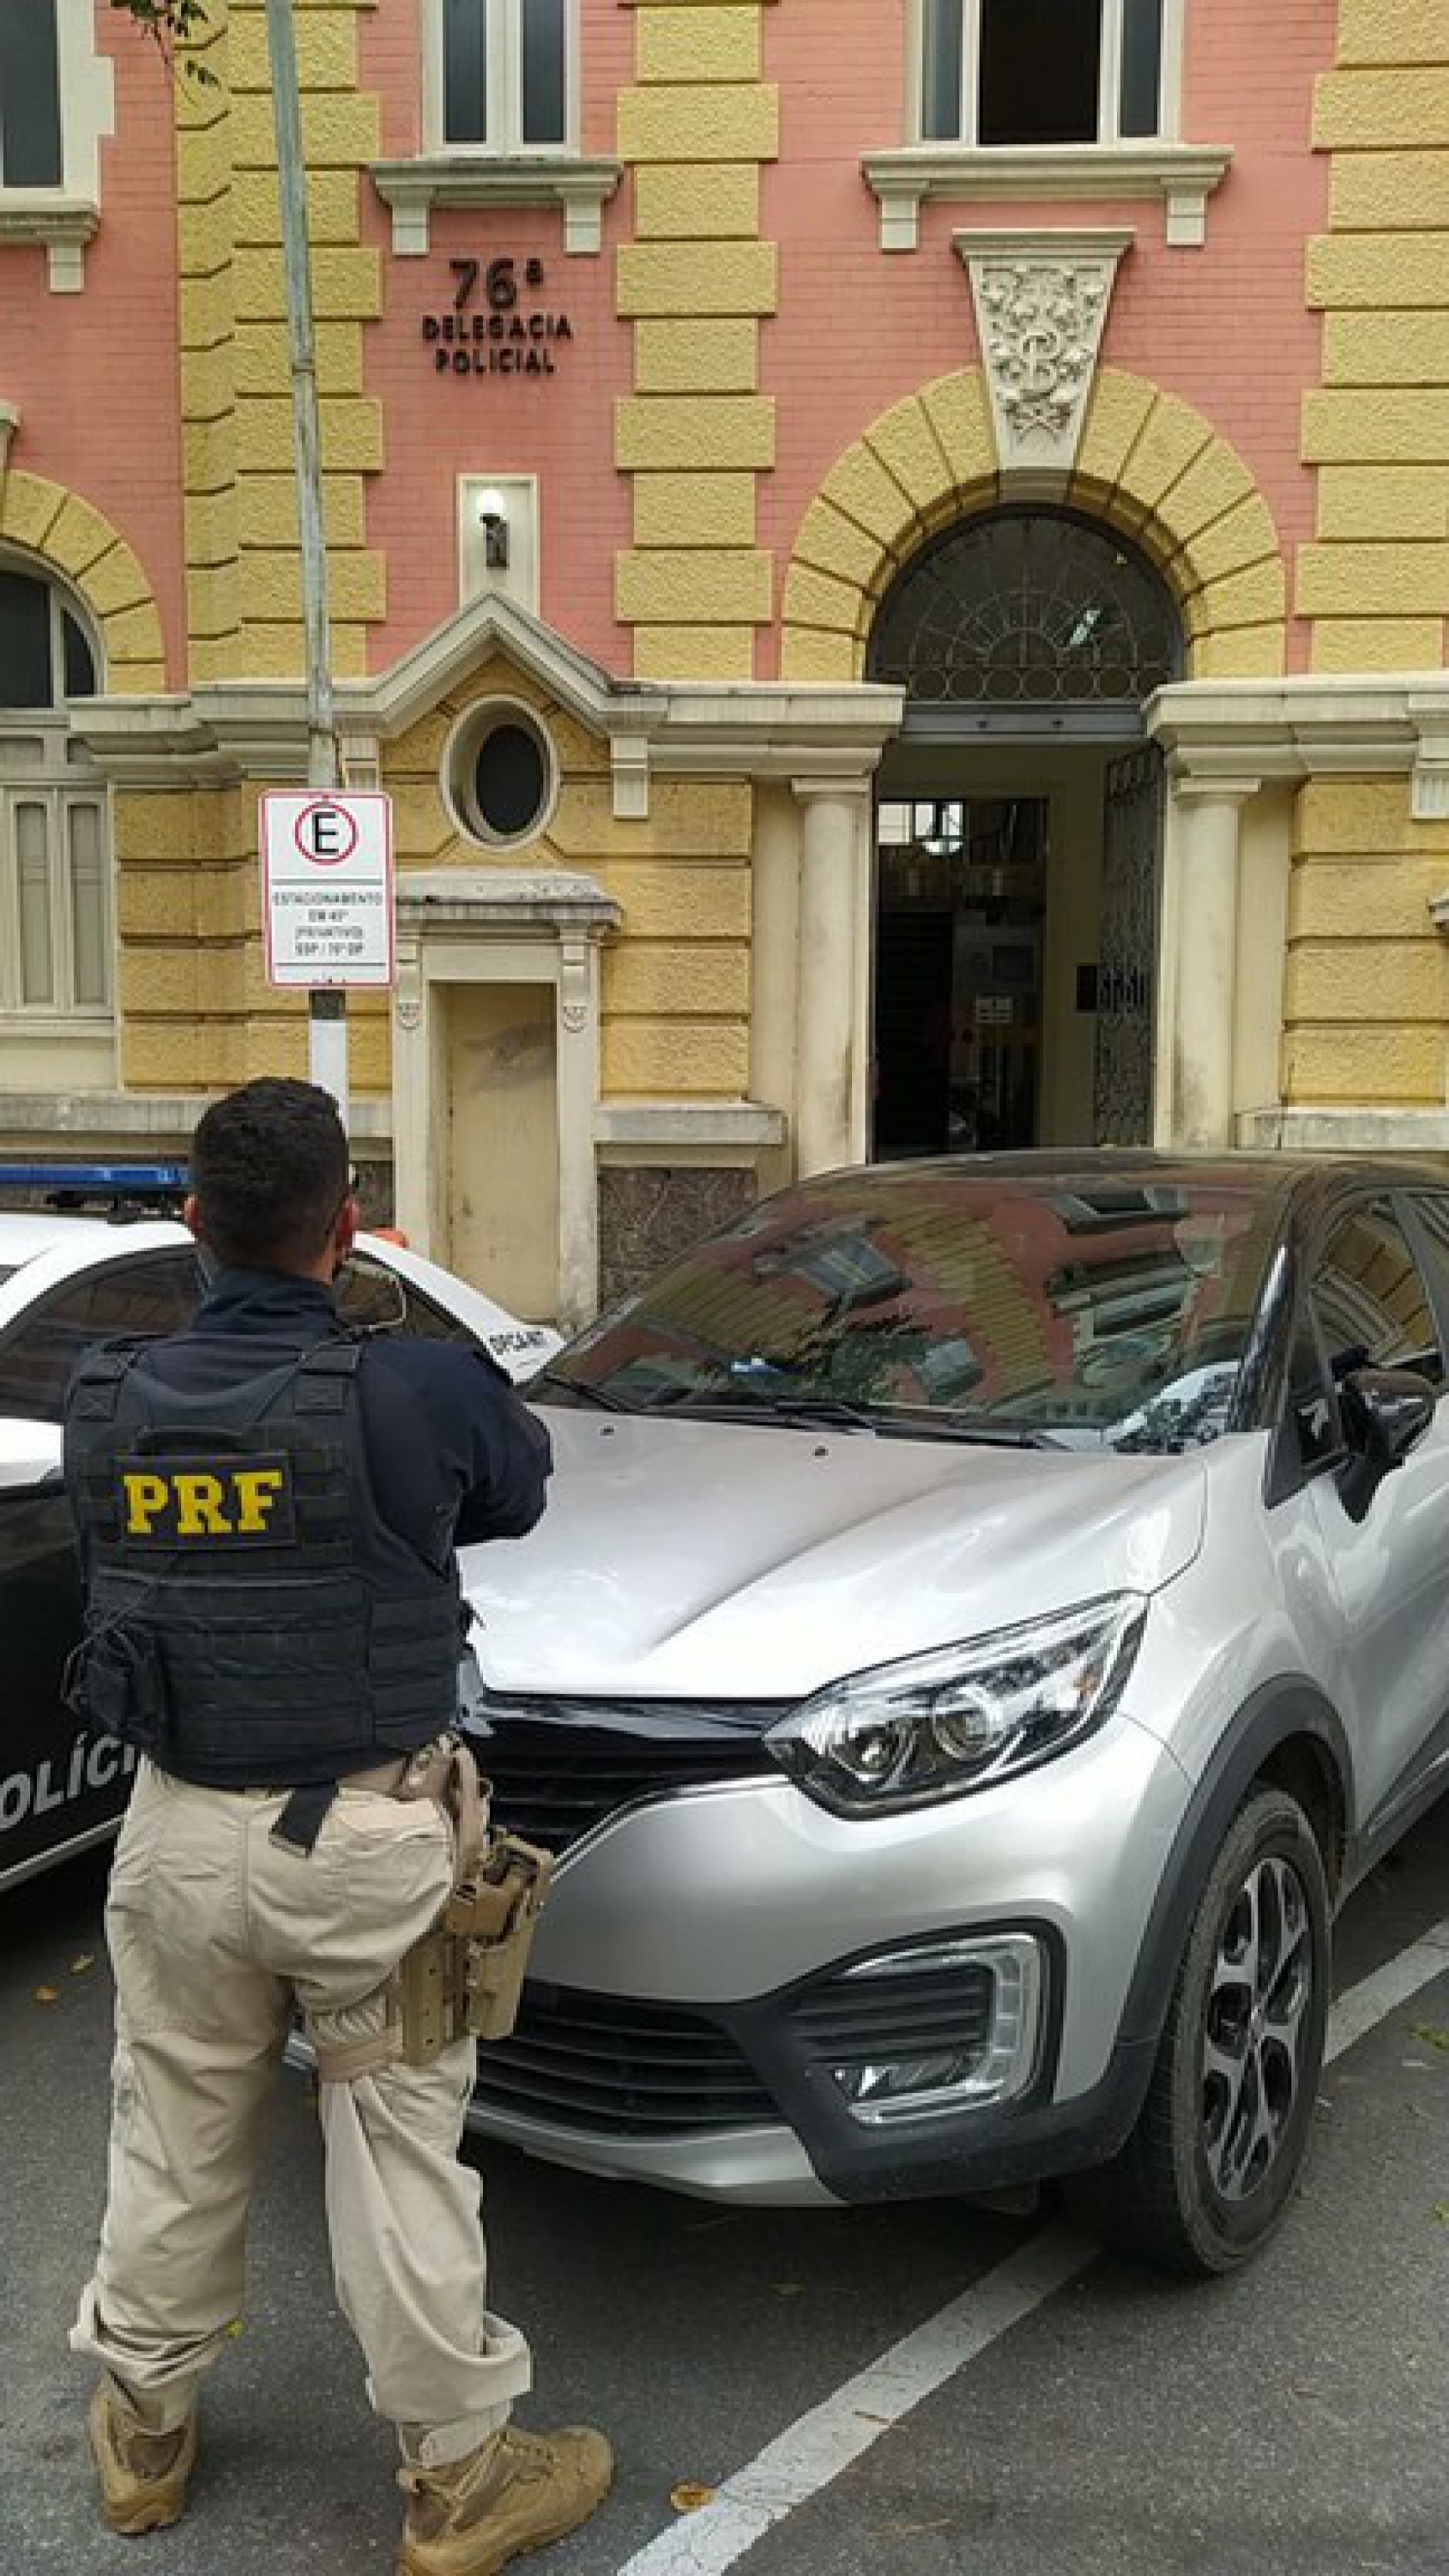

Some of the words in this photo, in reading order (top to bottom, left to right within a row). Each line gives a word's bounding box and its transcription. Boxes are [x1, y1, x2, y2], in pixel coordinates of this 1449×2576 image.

[449, 258, 543, 309] 76ª
[423, 315, 573, 341] DELEGACIA
[435, 349, 554, 374] POLICIAL
[312, 812, 339, 855] E
[272, 893, 382, 905] ESTACIONAMENTO
[123, 1470, 282, 1533] PRF
[0, 1731, 135, 1829] OLÍCI
